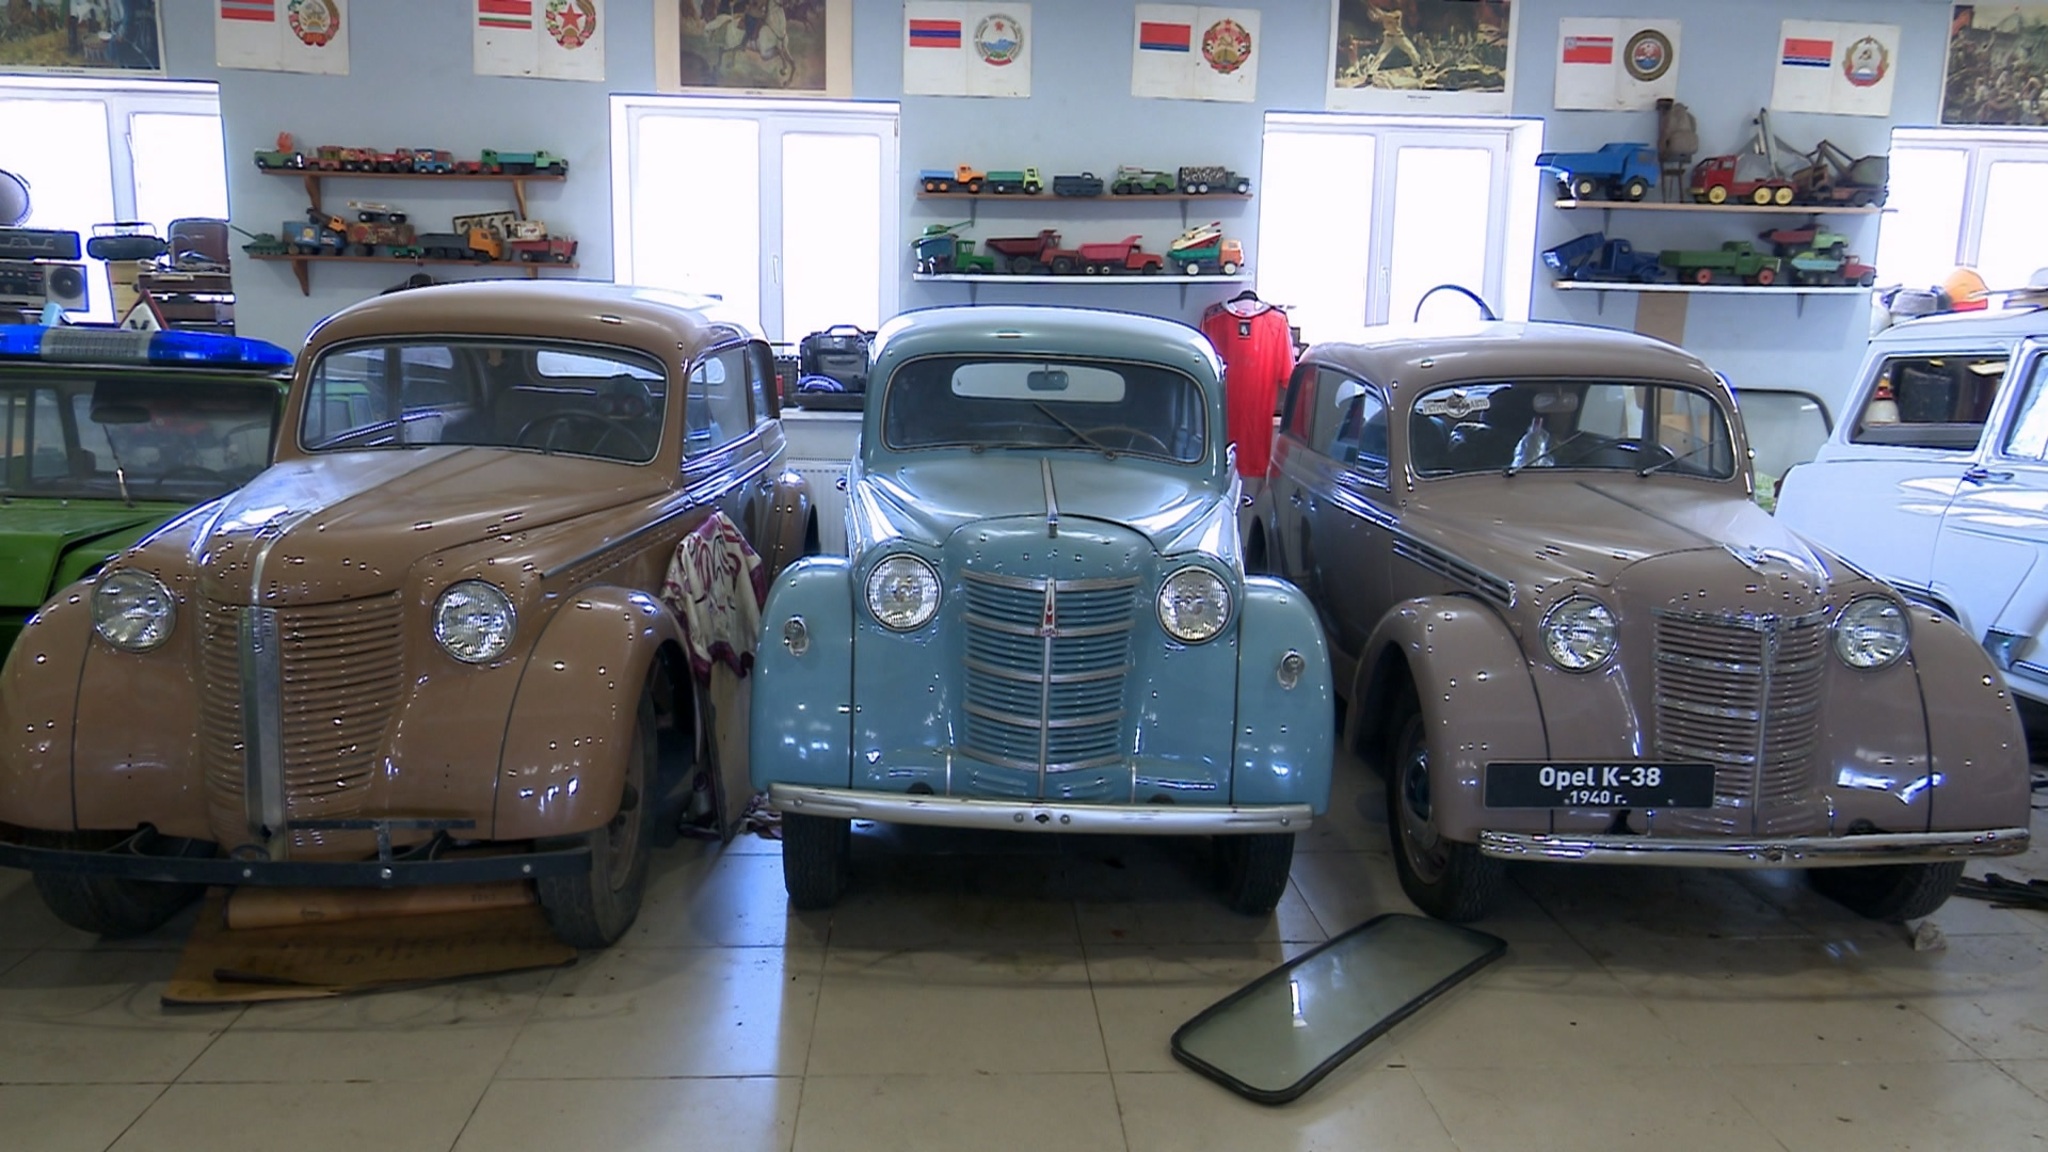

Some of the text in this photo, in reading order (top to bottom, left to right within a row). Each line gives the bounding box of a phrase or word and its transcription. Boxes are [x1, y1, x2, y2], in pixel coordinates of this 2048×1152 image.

[1540, 767, 1661, 790] Opel K-38
[1570, 791, 1627, 804] 1940 г.
